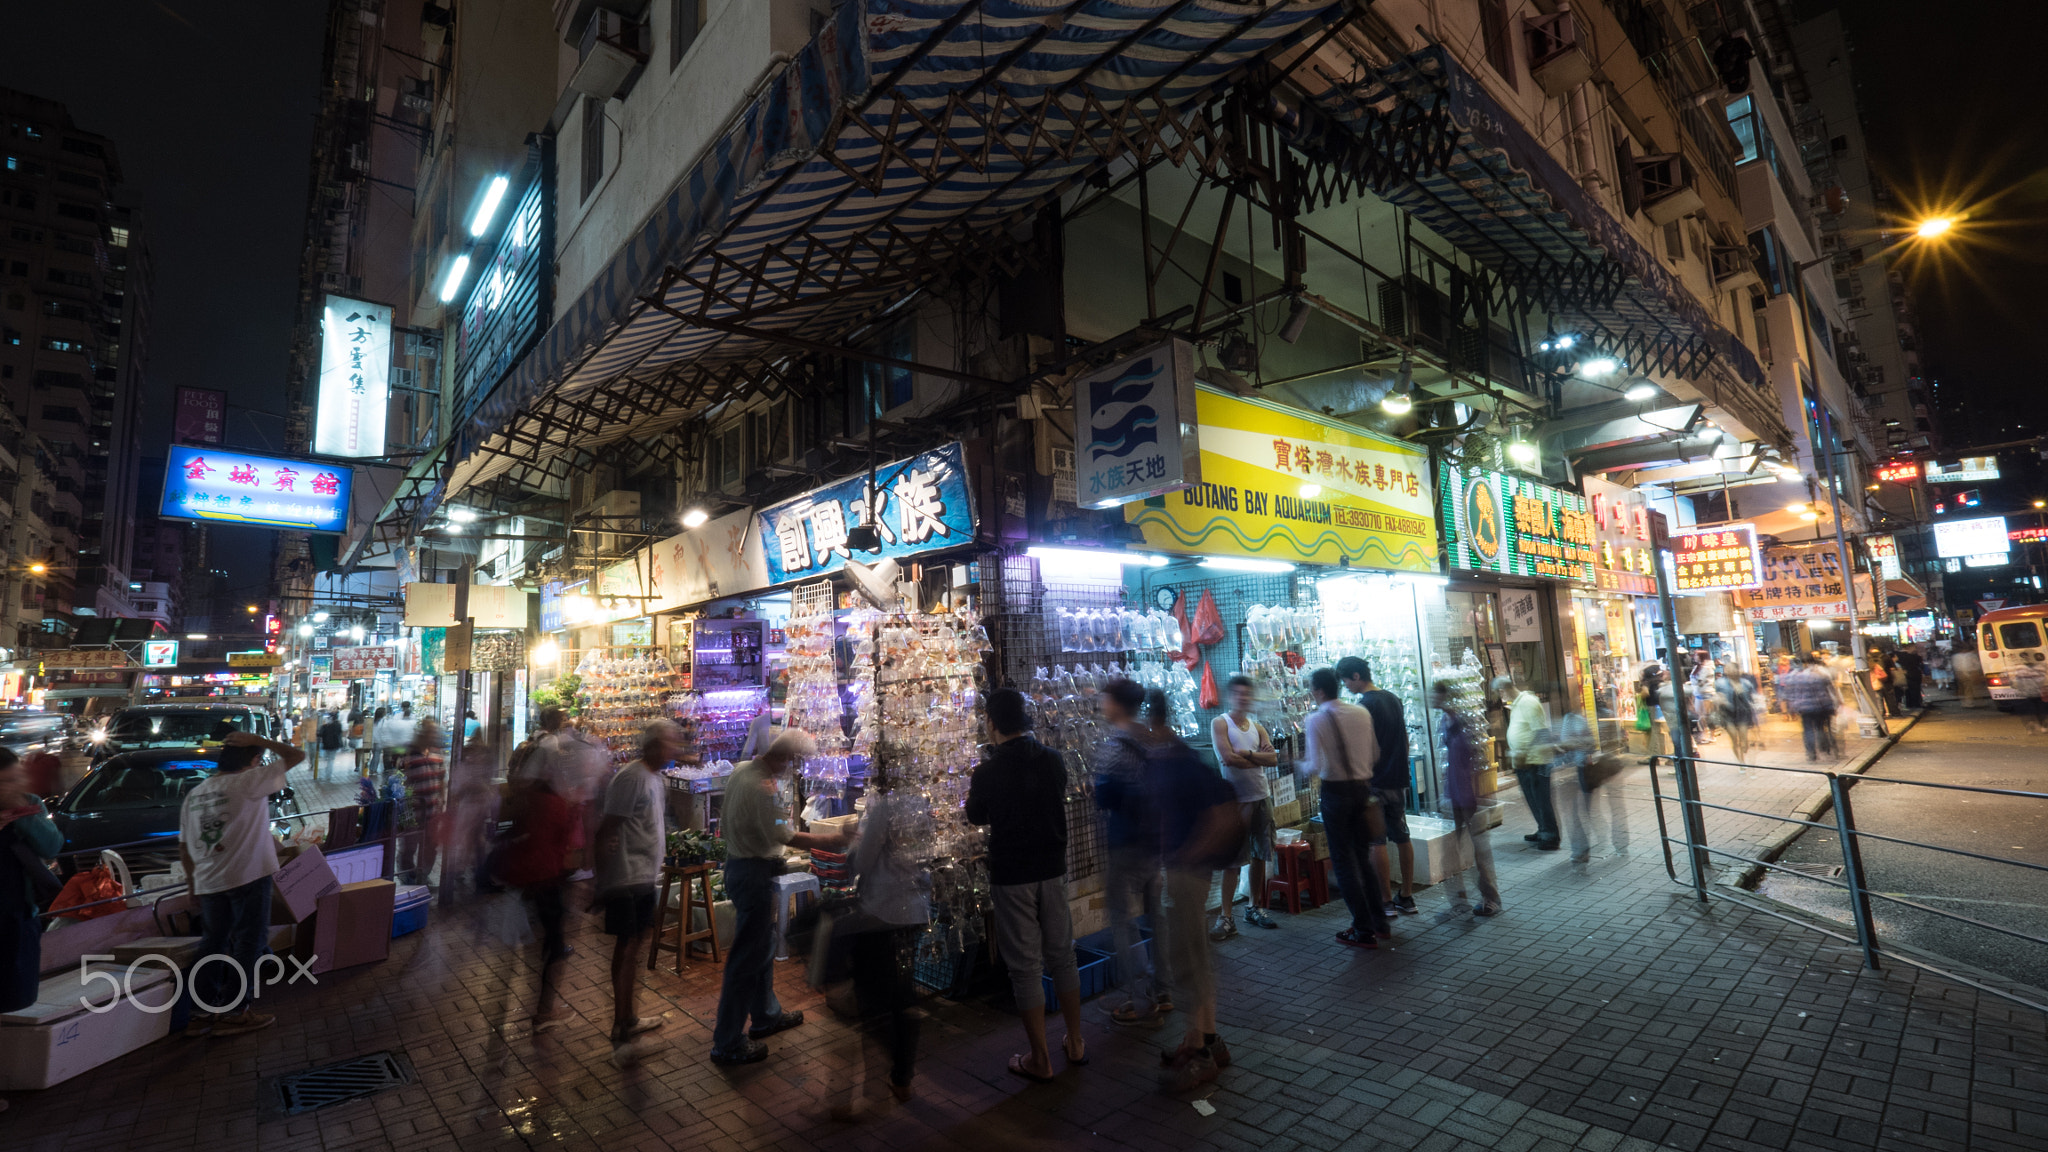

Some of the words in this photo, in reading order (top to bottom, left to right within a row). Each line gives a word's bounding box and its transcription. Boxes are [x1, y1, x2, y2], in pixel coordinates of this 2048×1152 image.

[345, 311, 377, 395] 八方雲集
[183, 398, 218, 409] FOOD
[184, 391, 205, 400] PET
[182, 456, 342, 496] 金城賓館
[1089, 453, 1167, 495] 水族天地
[1273, 438, 1420, 498] 寶塔灣水族專門店
[774, 467, 952, 574] 創興水族
[1244, 489, 1269, 516] BAY
[1274, 494, 1333, 526] AQUARIUM
[1334, 507, 1382, 530] TEL:3930710
[1514, 488, 1559, 539] 泰國人
[1683, 532, 1739, 551] 川味皇
[1761, 552, 1839, 568] UPER
[1762, 566, 1839, 581] UTLET
[1750, 582, 1843, 601] 名牌特價城
